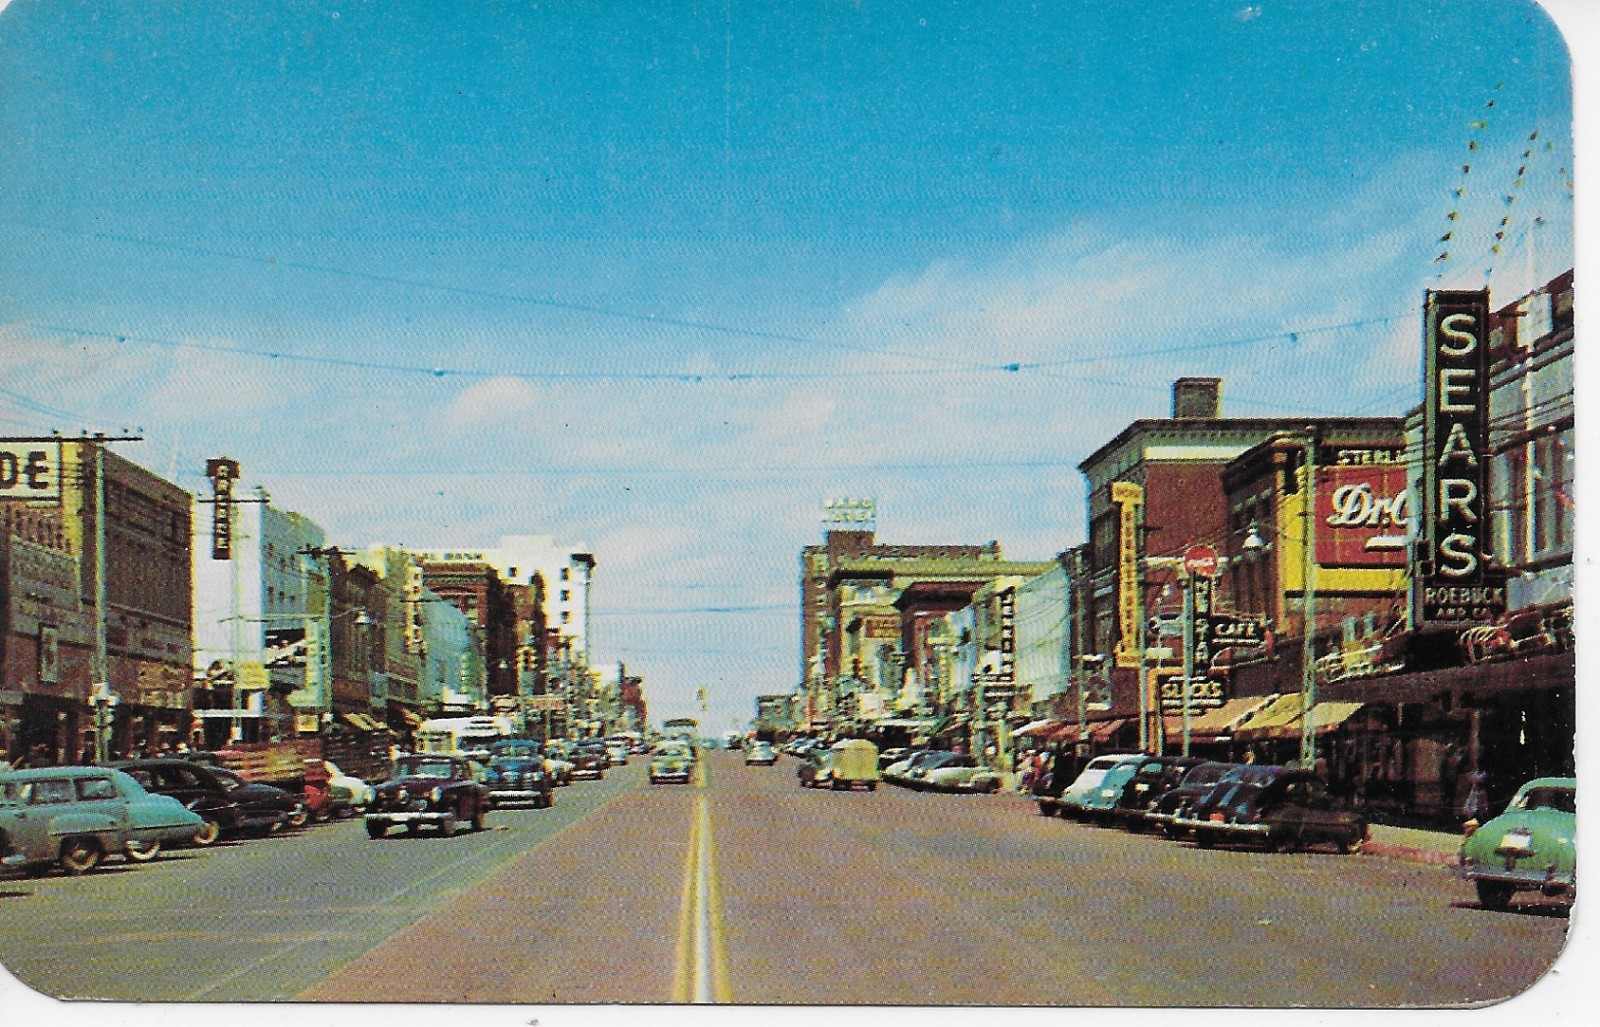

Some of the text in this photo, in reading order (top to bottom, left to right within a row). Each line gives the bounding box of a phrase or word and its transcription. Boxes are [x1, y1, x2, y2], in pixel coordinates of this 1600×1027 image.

[1439, 312, 1478, 577] SEARS
[1424, 586, 1504, 606] ROEBUCK
[1214, 622, 1256, 637] CAFE
